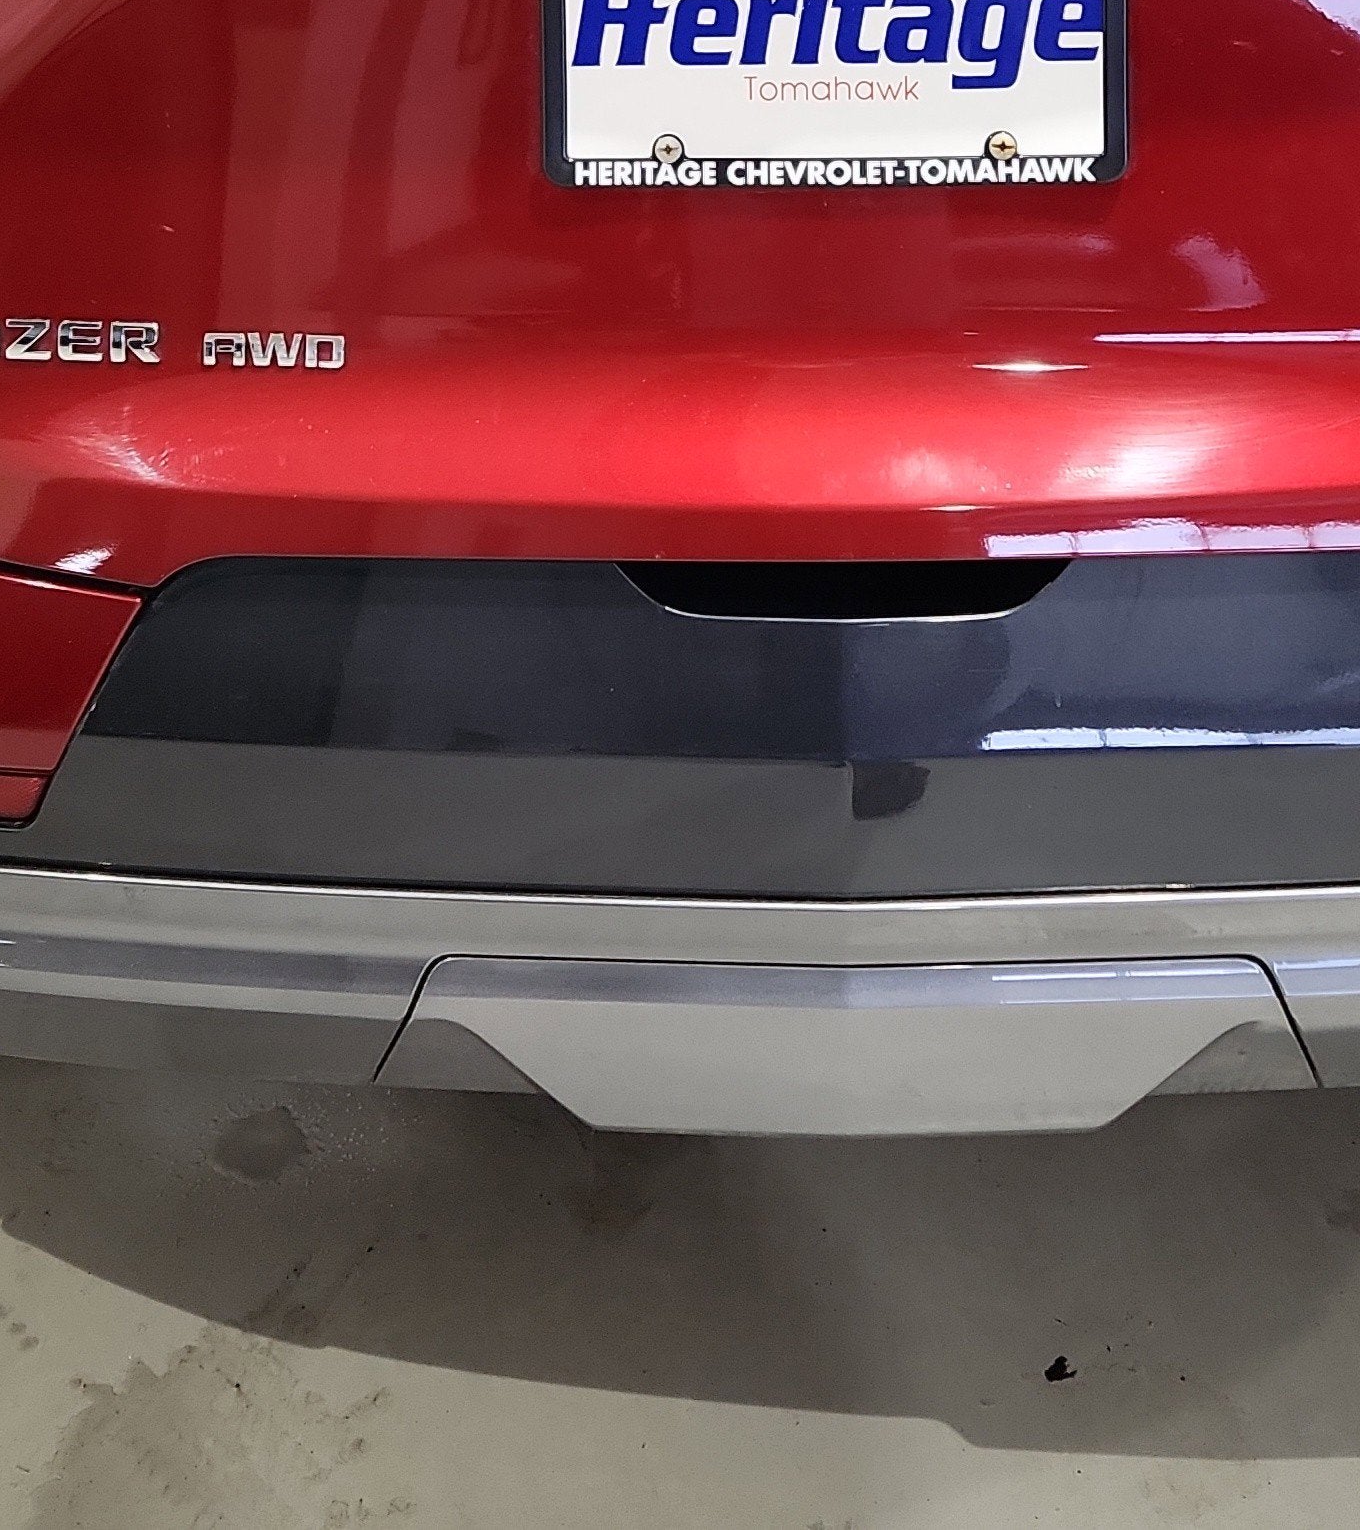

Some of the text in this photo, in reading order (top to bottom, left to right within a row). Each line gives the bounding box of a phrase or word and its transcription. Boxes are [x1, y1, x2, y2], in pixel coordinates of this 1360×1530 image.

[743, 75, 920, 102] Tomahawk
[573, 155, 1098, 188] HERITAGE CHEVROLET-TOMAHAWK
[202, 332, 347, 370] AWD
